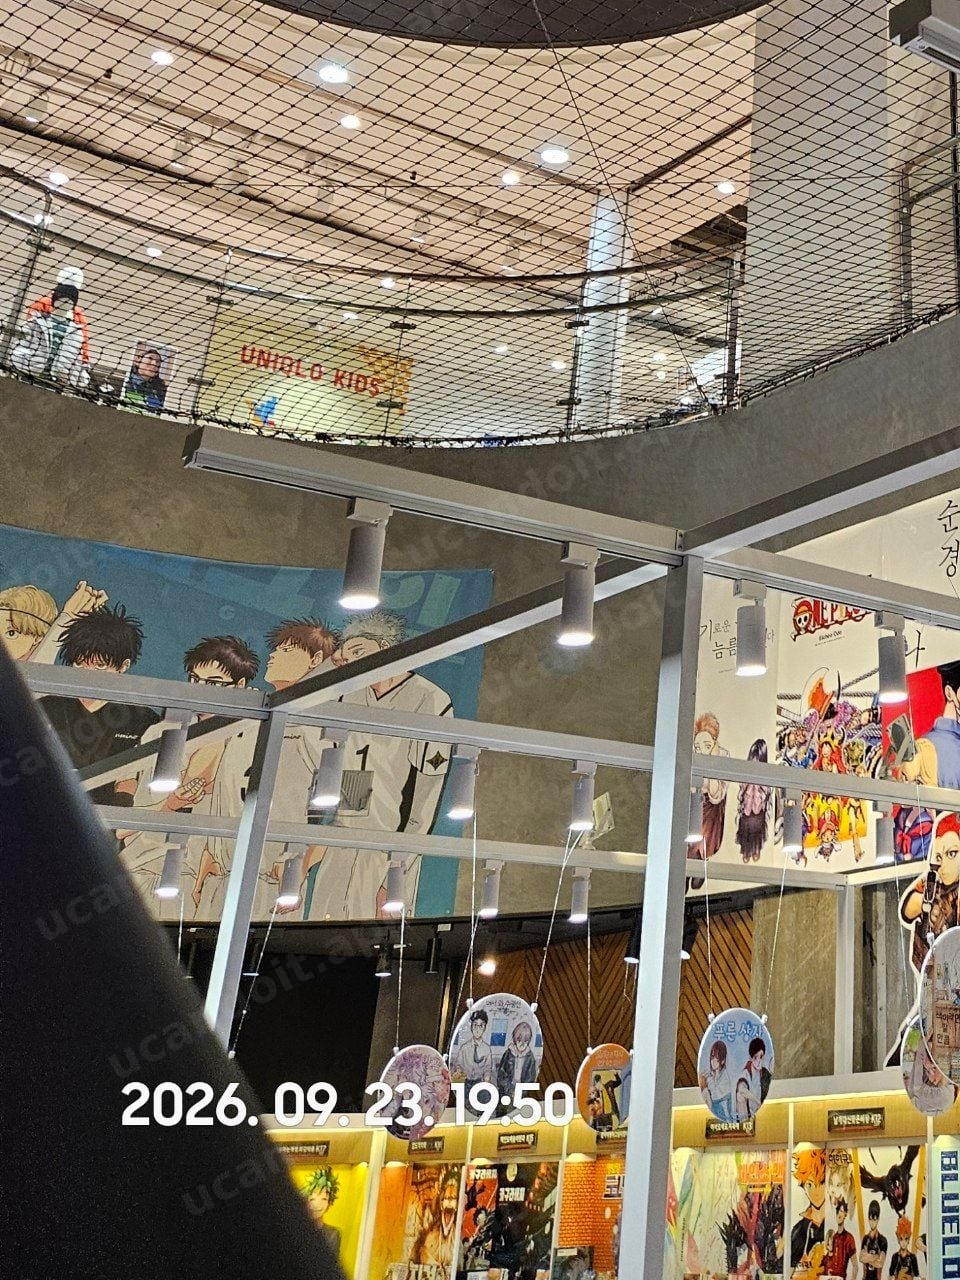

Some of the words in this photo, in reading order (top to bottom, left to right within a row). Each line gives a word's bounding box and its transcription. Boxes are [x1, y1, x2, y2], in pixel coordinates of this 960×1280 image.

[240, 344, 323, 381] UNIQLO
[333, 369, 382, 397] KIDS
[713, 1021, 736, 1042] 푸른
[740, 1019, 763, 1042] 상자
